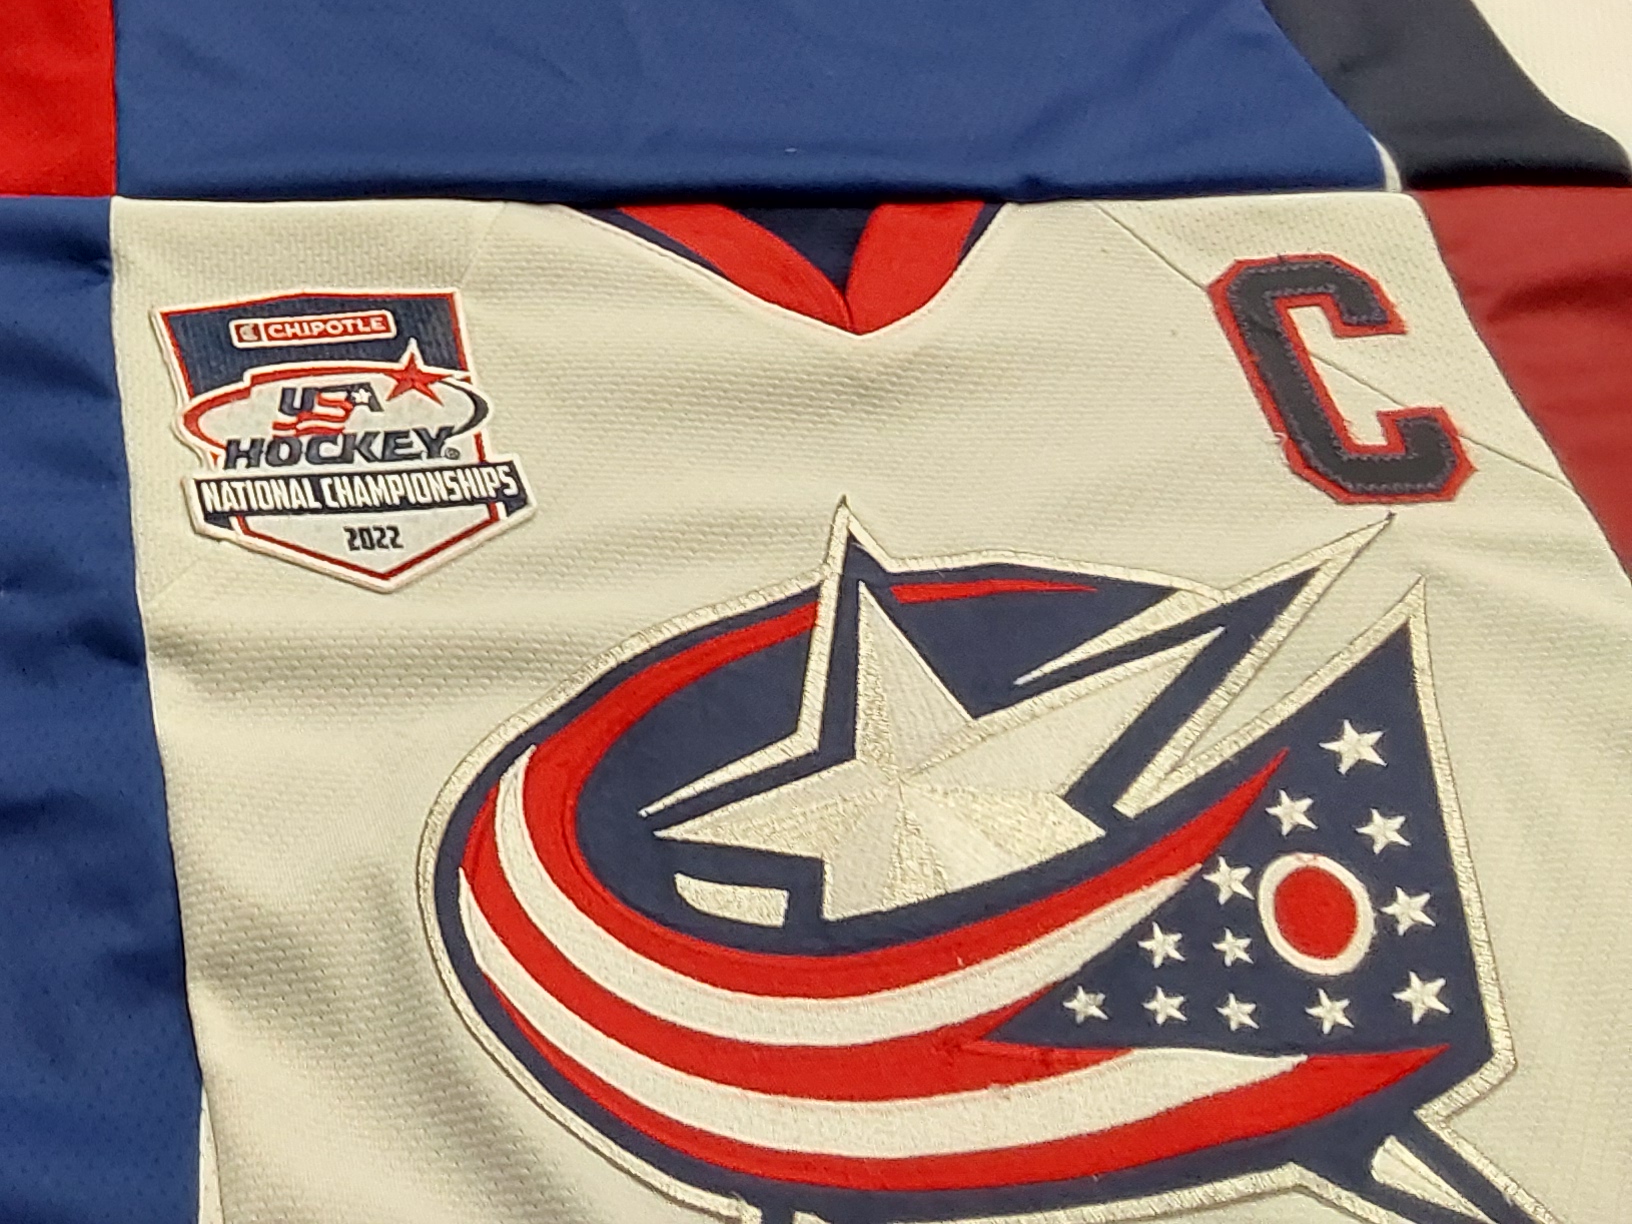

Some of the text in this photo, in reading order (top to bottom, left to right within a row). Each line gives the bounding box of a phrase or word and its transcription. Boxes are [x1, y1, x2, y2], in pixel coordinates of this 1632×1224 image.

[270, 315, 389, 341] CHIPOTLE
[1205, 252, 1477, 505] C
[276, 381, 385, 424] USA
[200, 466, 519, 514] NATIONAL CHAMPIONSHIPS
[343, 525, 404, 552] 2022
